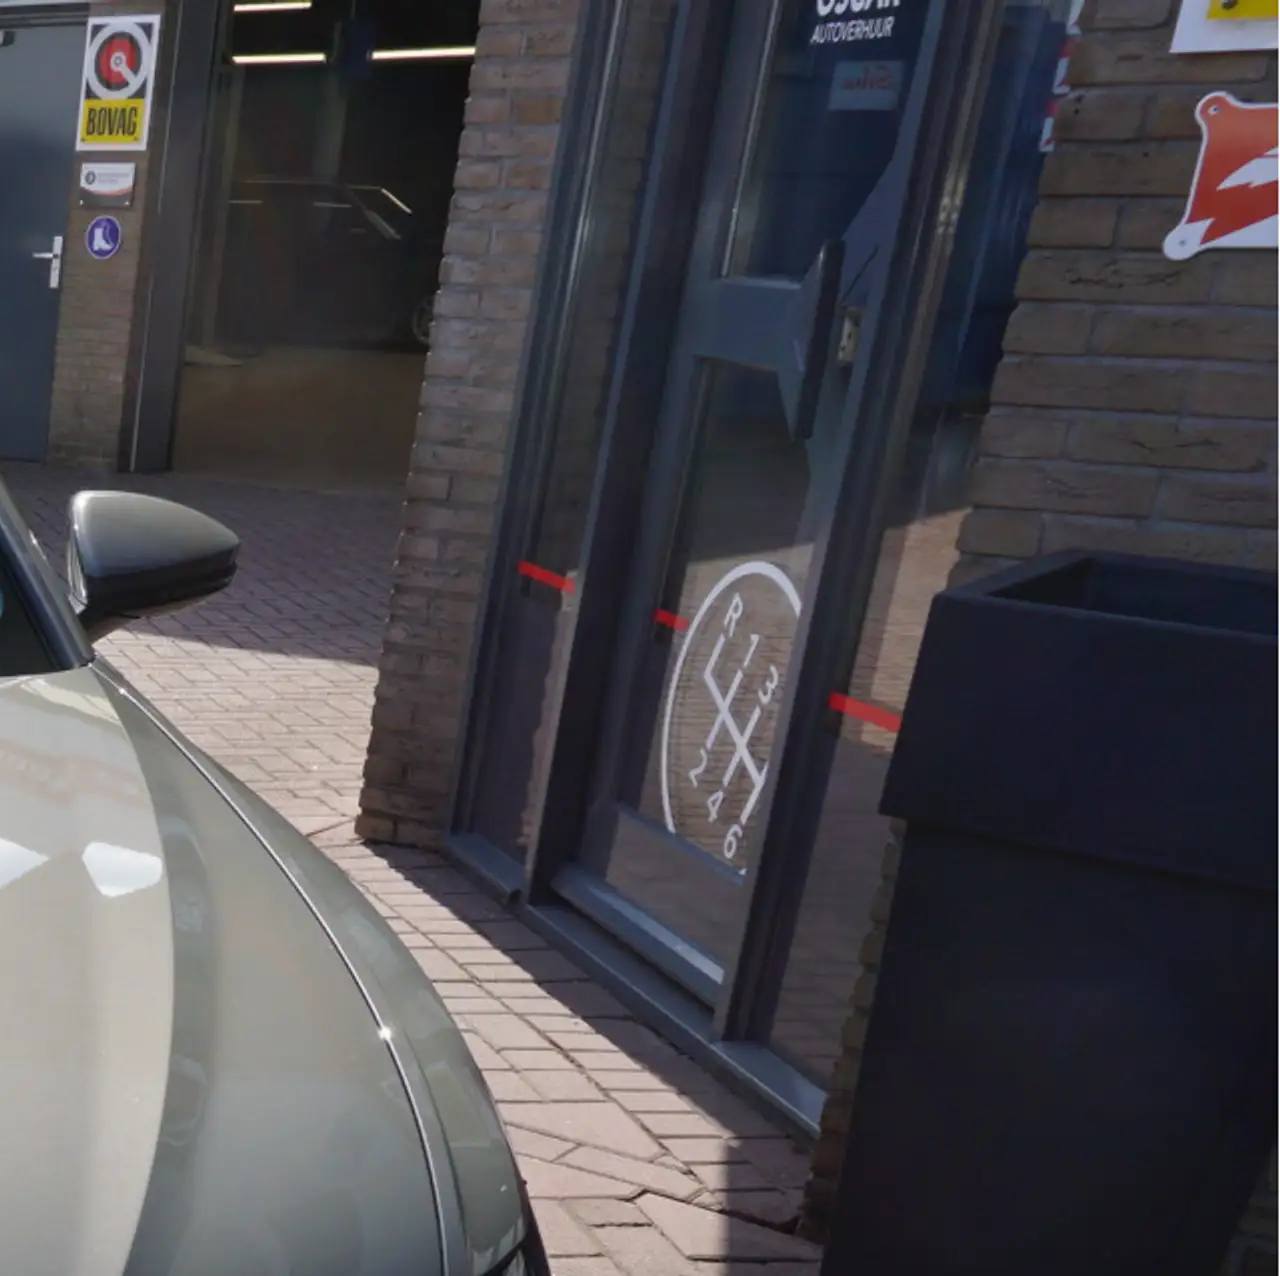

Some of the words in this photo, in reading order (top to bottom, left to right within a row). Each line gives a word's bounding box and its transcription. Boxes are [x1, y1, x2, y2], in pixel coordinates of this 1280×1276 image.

[810, 16, 895, 43] AUTOVERHUUR
[87, 107, 138, 136] BOVAG
[724, 591, 744, 637] R
[743, 634, 759, 667] 1
[759, 665, 779, 705] 3
[688, 747, 708, 788] 2
[707, 790, 725, 824] 4
[724, 823, 744, 859] 6
